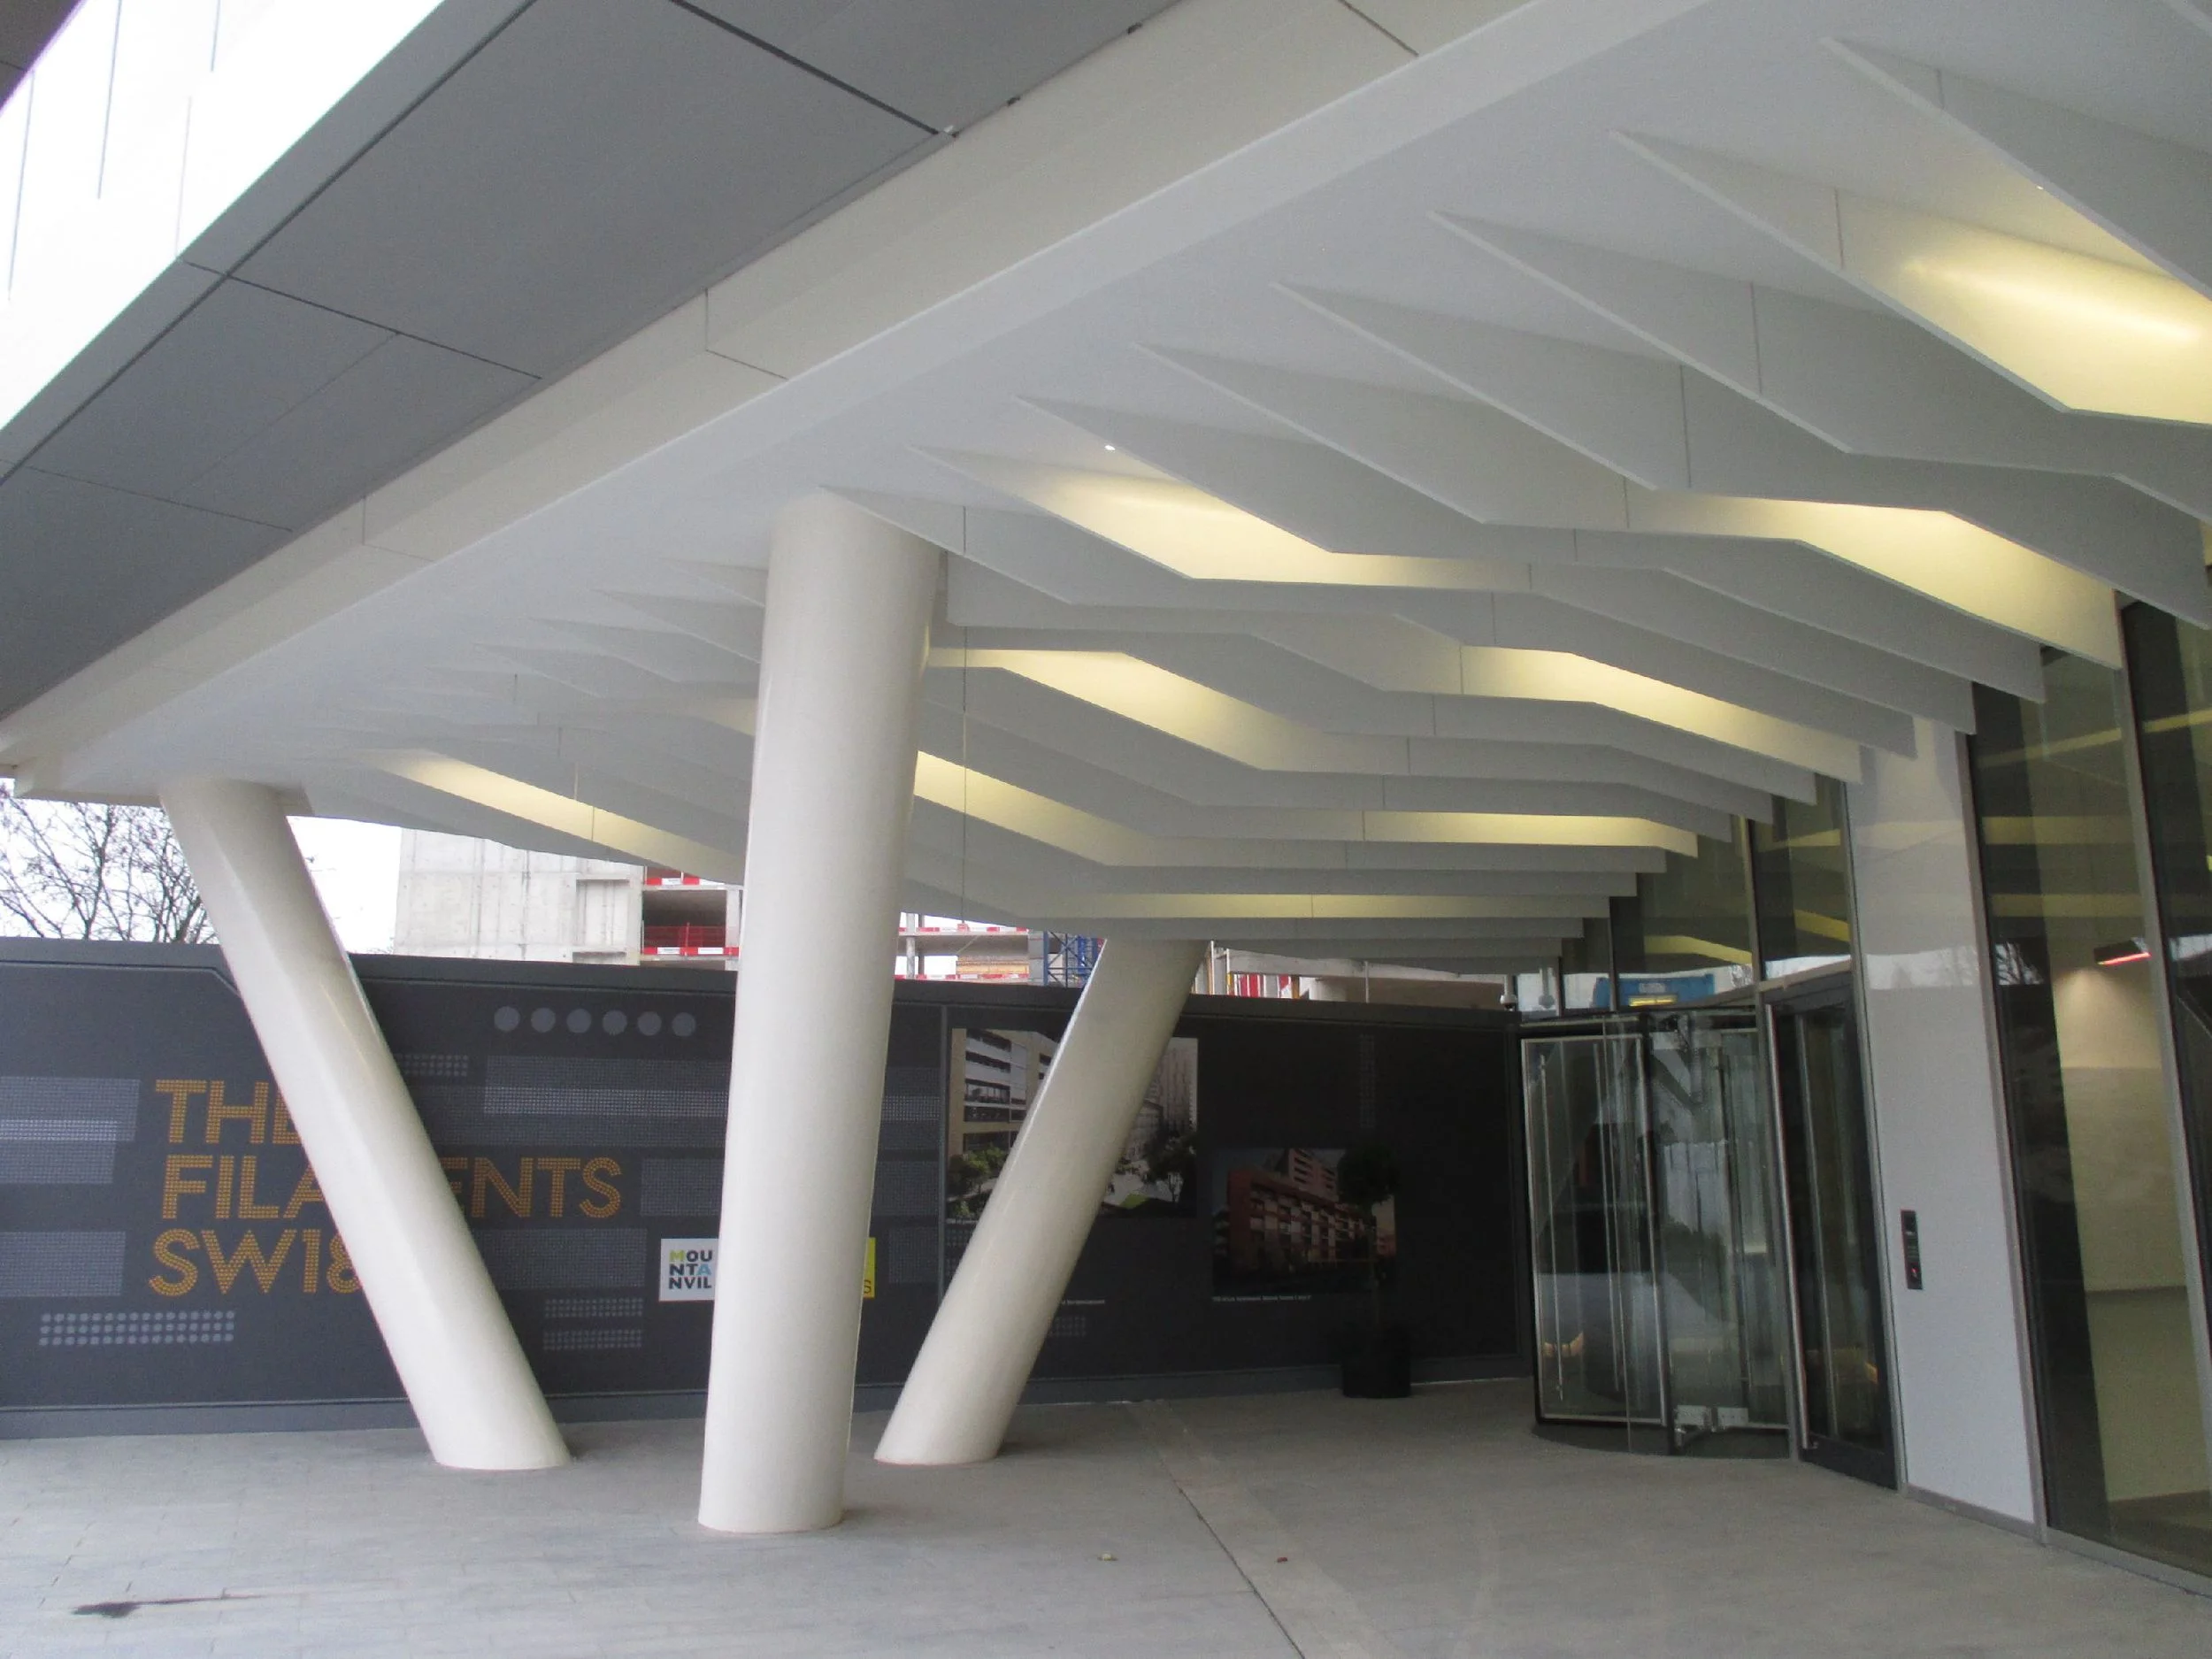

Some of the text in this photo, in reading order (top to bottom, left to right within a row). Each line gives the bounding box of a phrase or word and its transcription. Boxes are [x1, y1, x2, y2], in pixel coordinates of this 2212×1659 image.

[669, 1249, 712, 1262] MOU
[149, 1228, 363, 1296] SW18
[669, 1263, 711, 1275] NTA
[669, 1277, 711, 1289] NVIL
